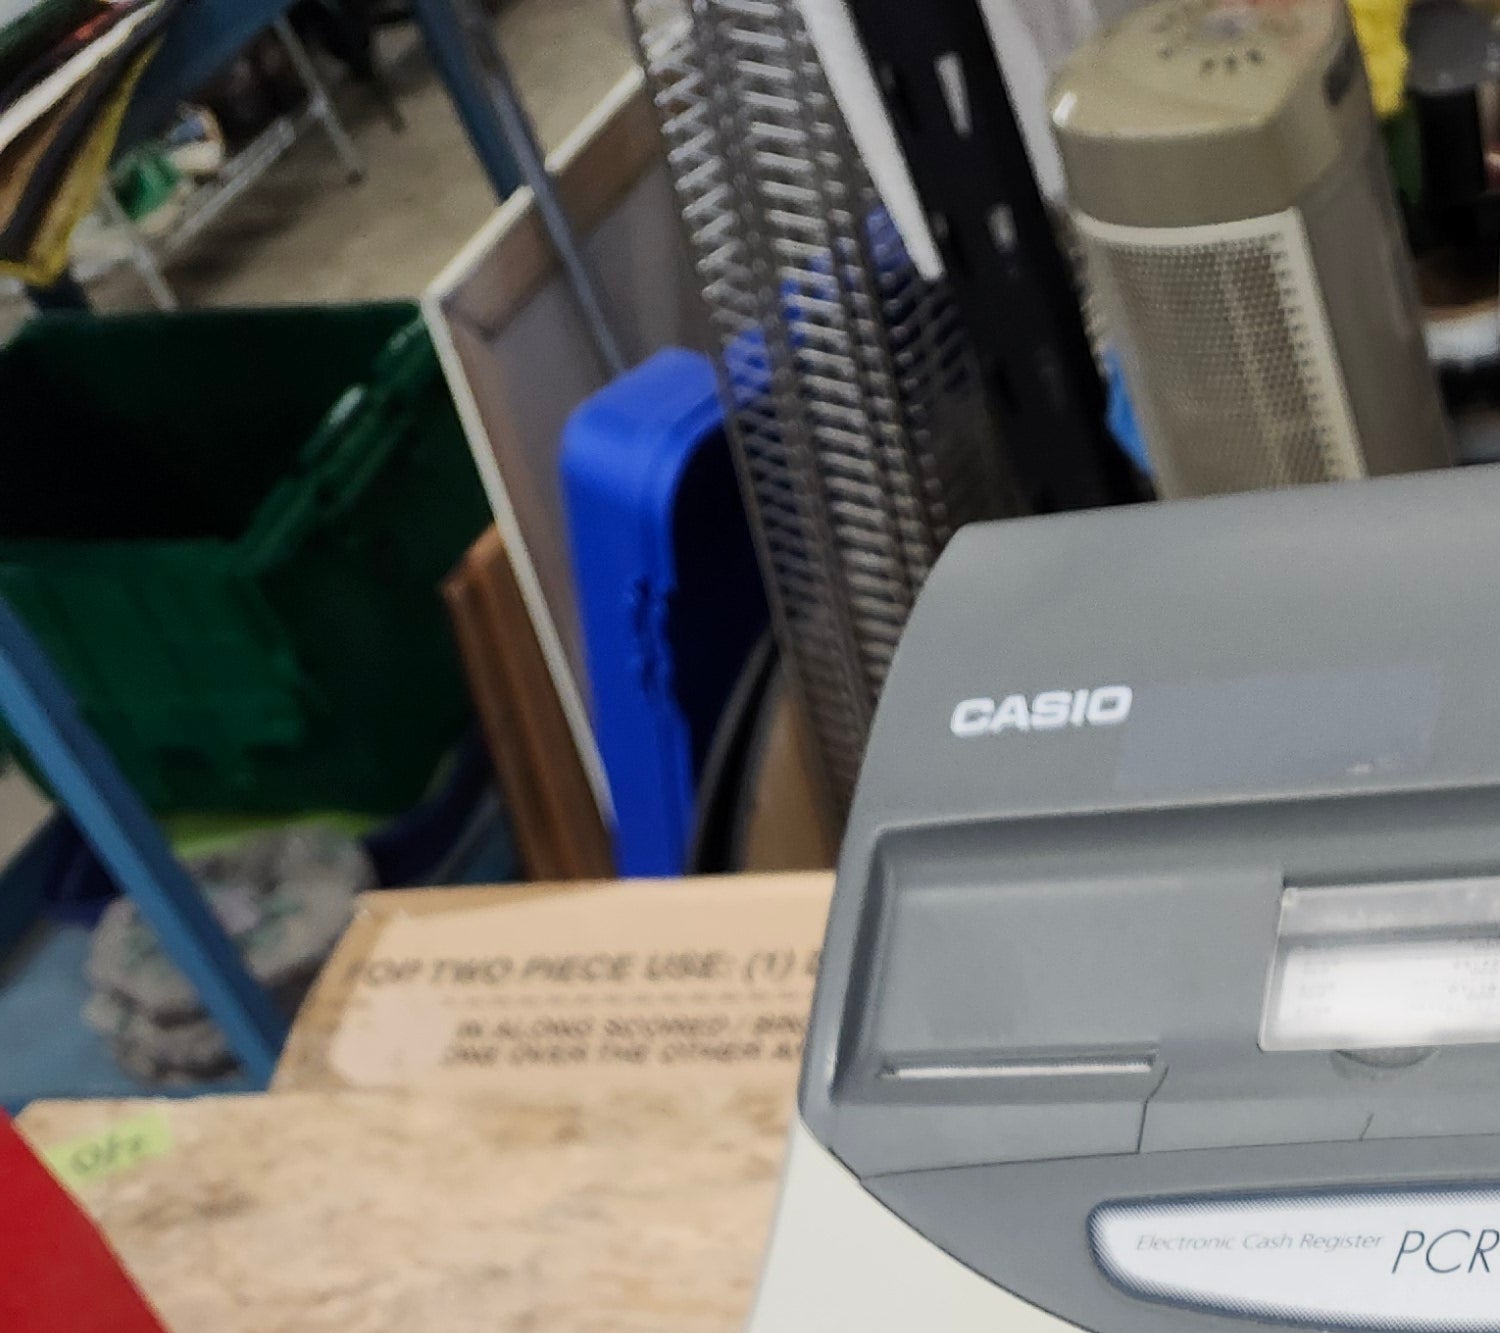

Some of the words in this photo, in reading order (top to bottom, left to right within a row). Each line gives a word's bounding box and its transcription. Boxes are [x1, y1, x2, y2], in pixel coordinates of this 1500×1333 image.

[950, 684, 1133, 738] CASIO
[1136, 1233, 1235, 1250] Electronic
[1241, 1233, 1293, 1249] Cash
[1299, 1232, 1384, 1252] Register
